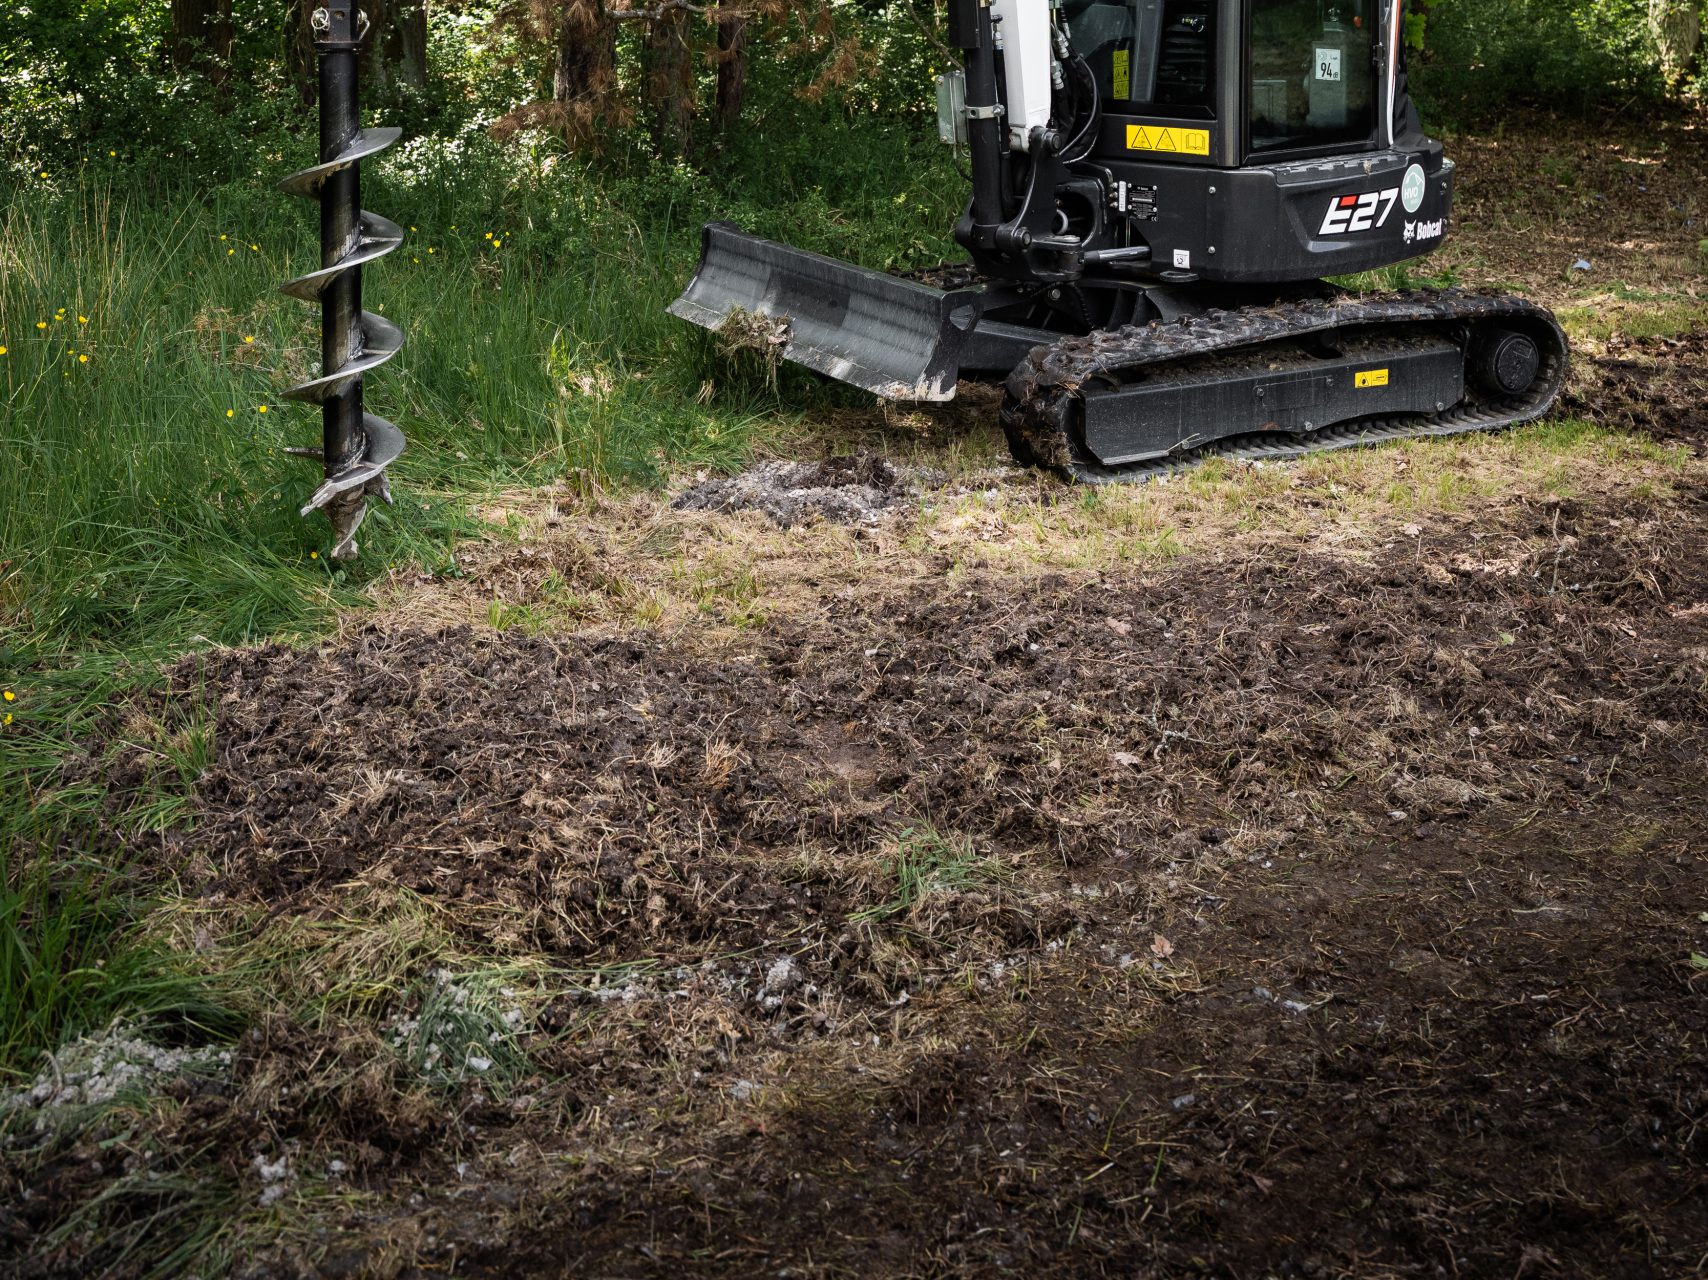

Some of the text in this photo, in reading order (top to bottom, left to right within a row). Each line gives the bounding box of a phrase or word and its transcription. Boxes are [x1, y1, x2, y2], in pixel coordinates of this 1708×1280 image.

[1320, 62, 1332, 78] 94
[1404, 186, 1419, 200] HVO
[1318, 187, 1400, 235] E27
[1416, 217, 1442, 241] Bobcat
